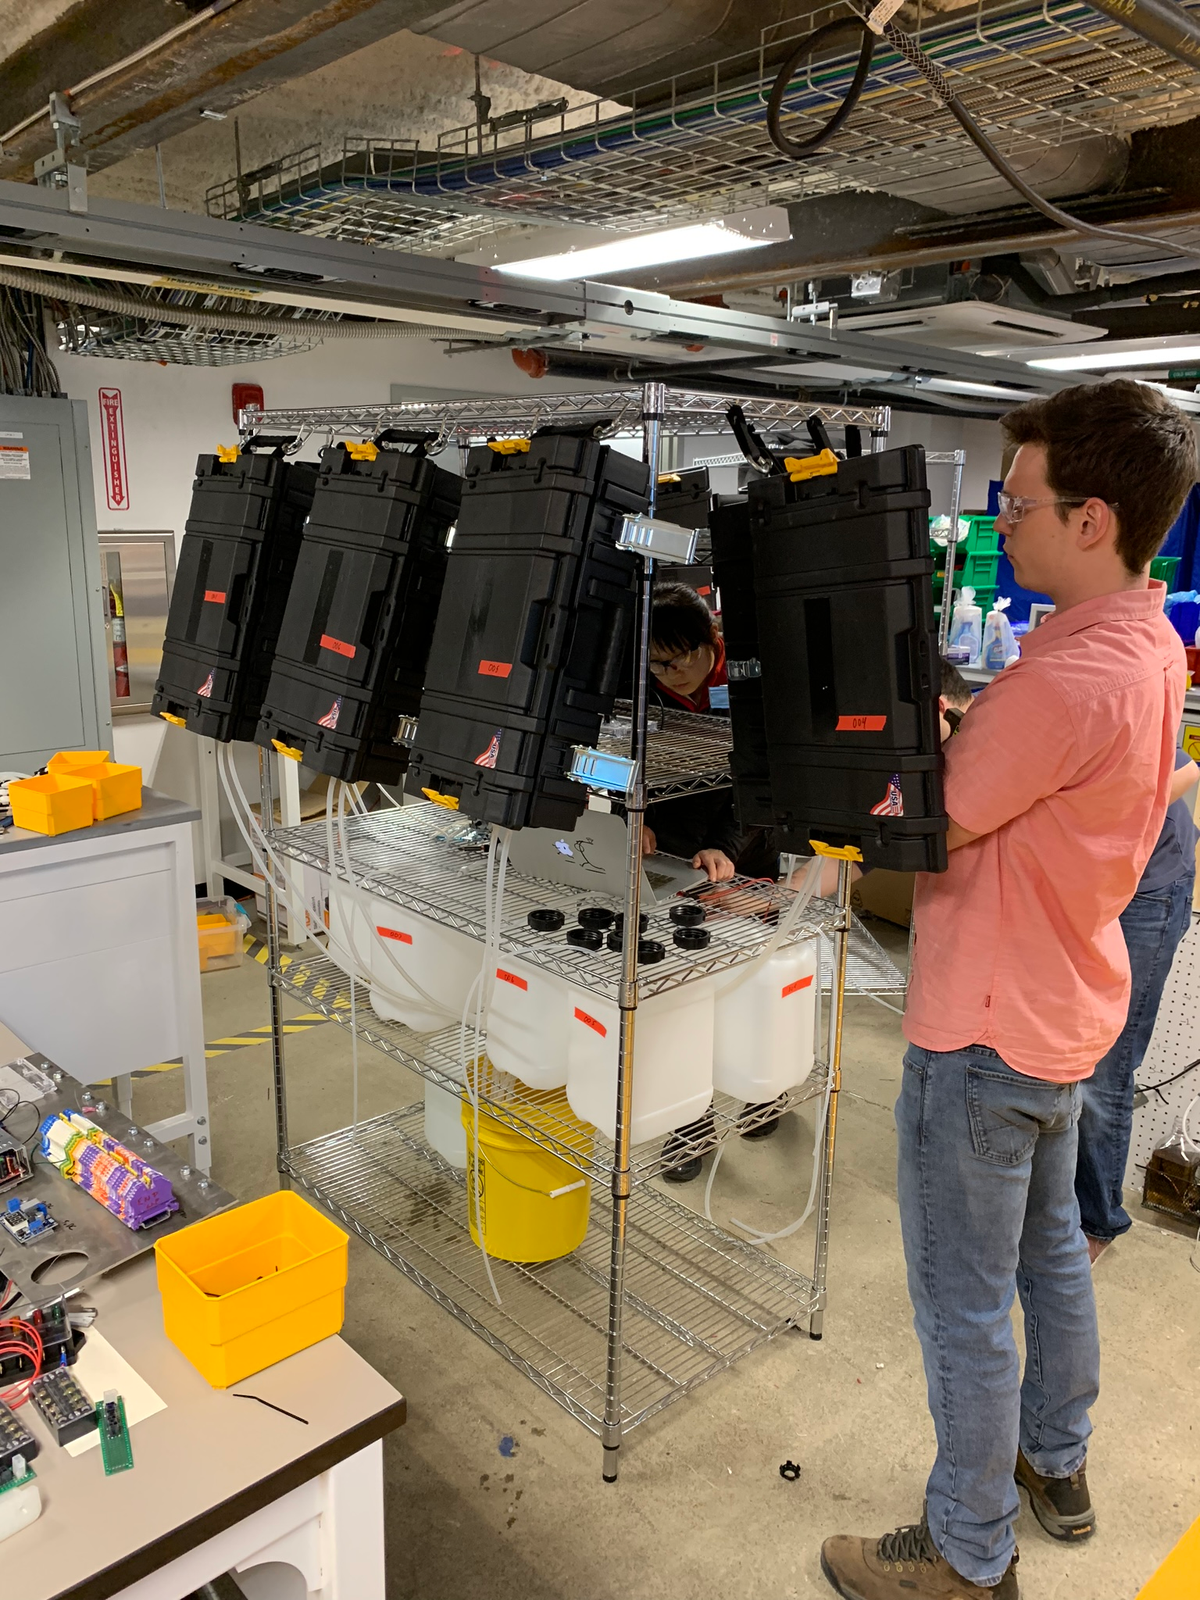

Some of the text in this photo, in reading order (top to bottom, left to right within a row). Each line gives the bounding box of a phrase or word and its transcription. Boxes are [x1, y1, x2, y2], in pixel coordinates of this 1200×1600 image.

[103, 398, 119, 406] FIRE
[108, 408, 121, 501] EXTINGUISHER
[852, 717, 867, 729] 004
[890, 791, 898, 806] USA
[137, 1192, 159, 1206] END
